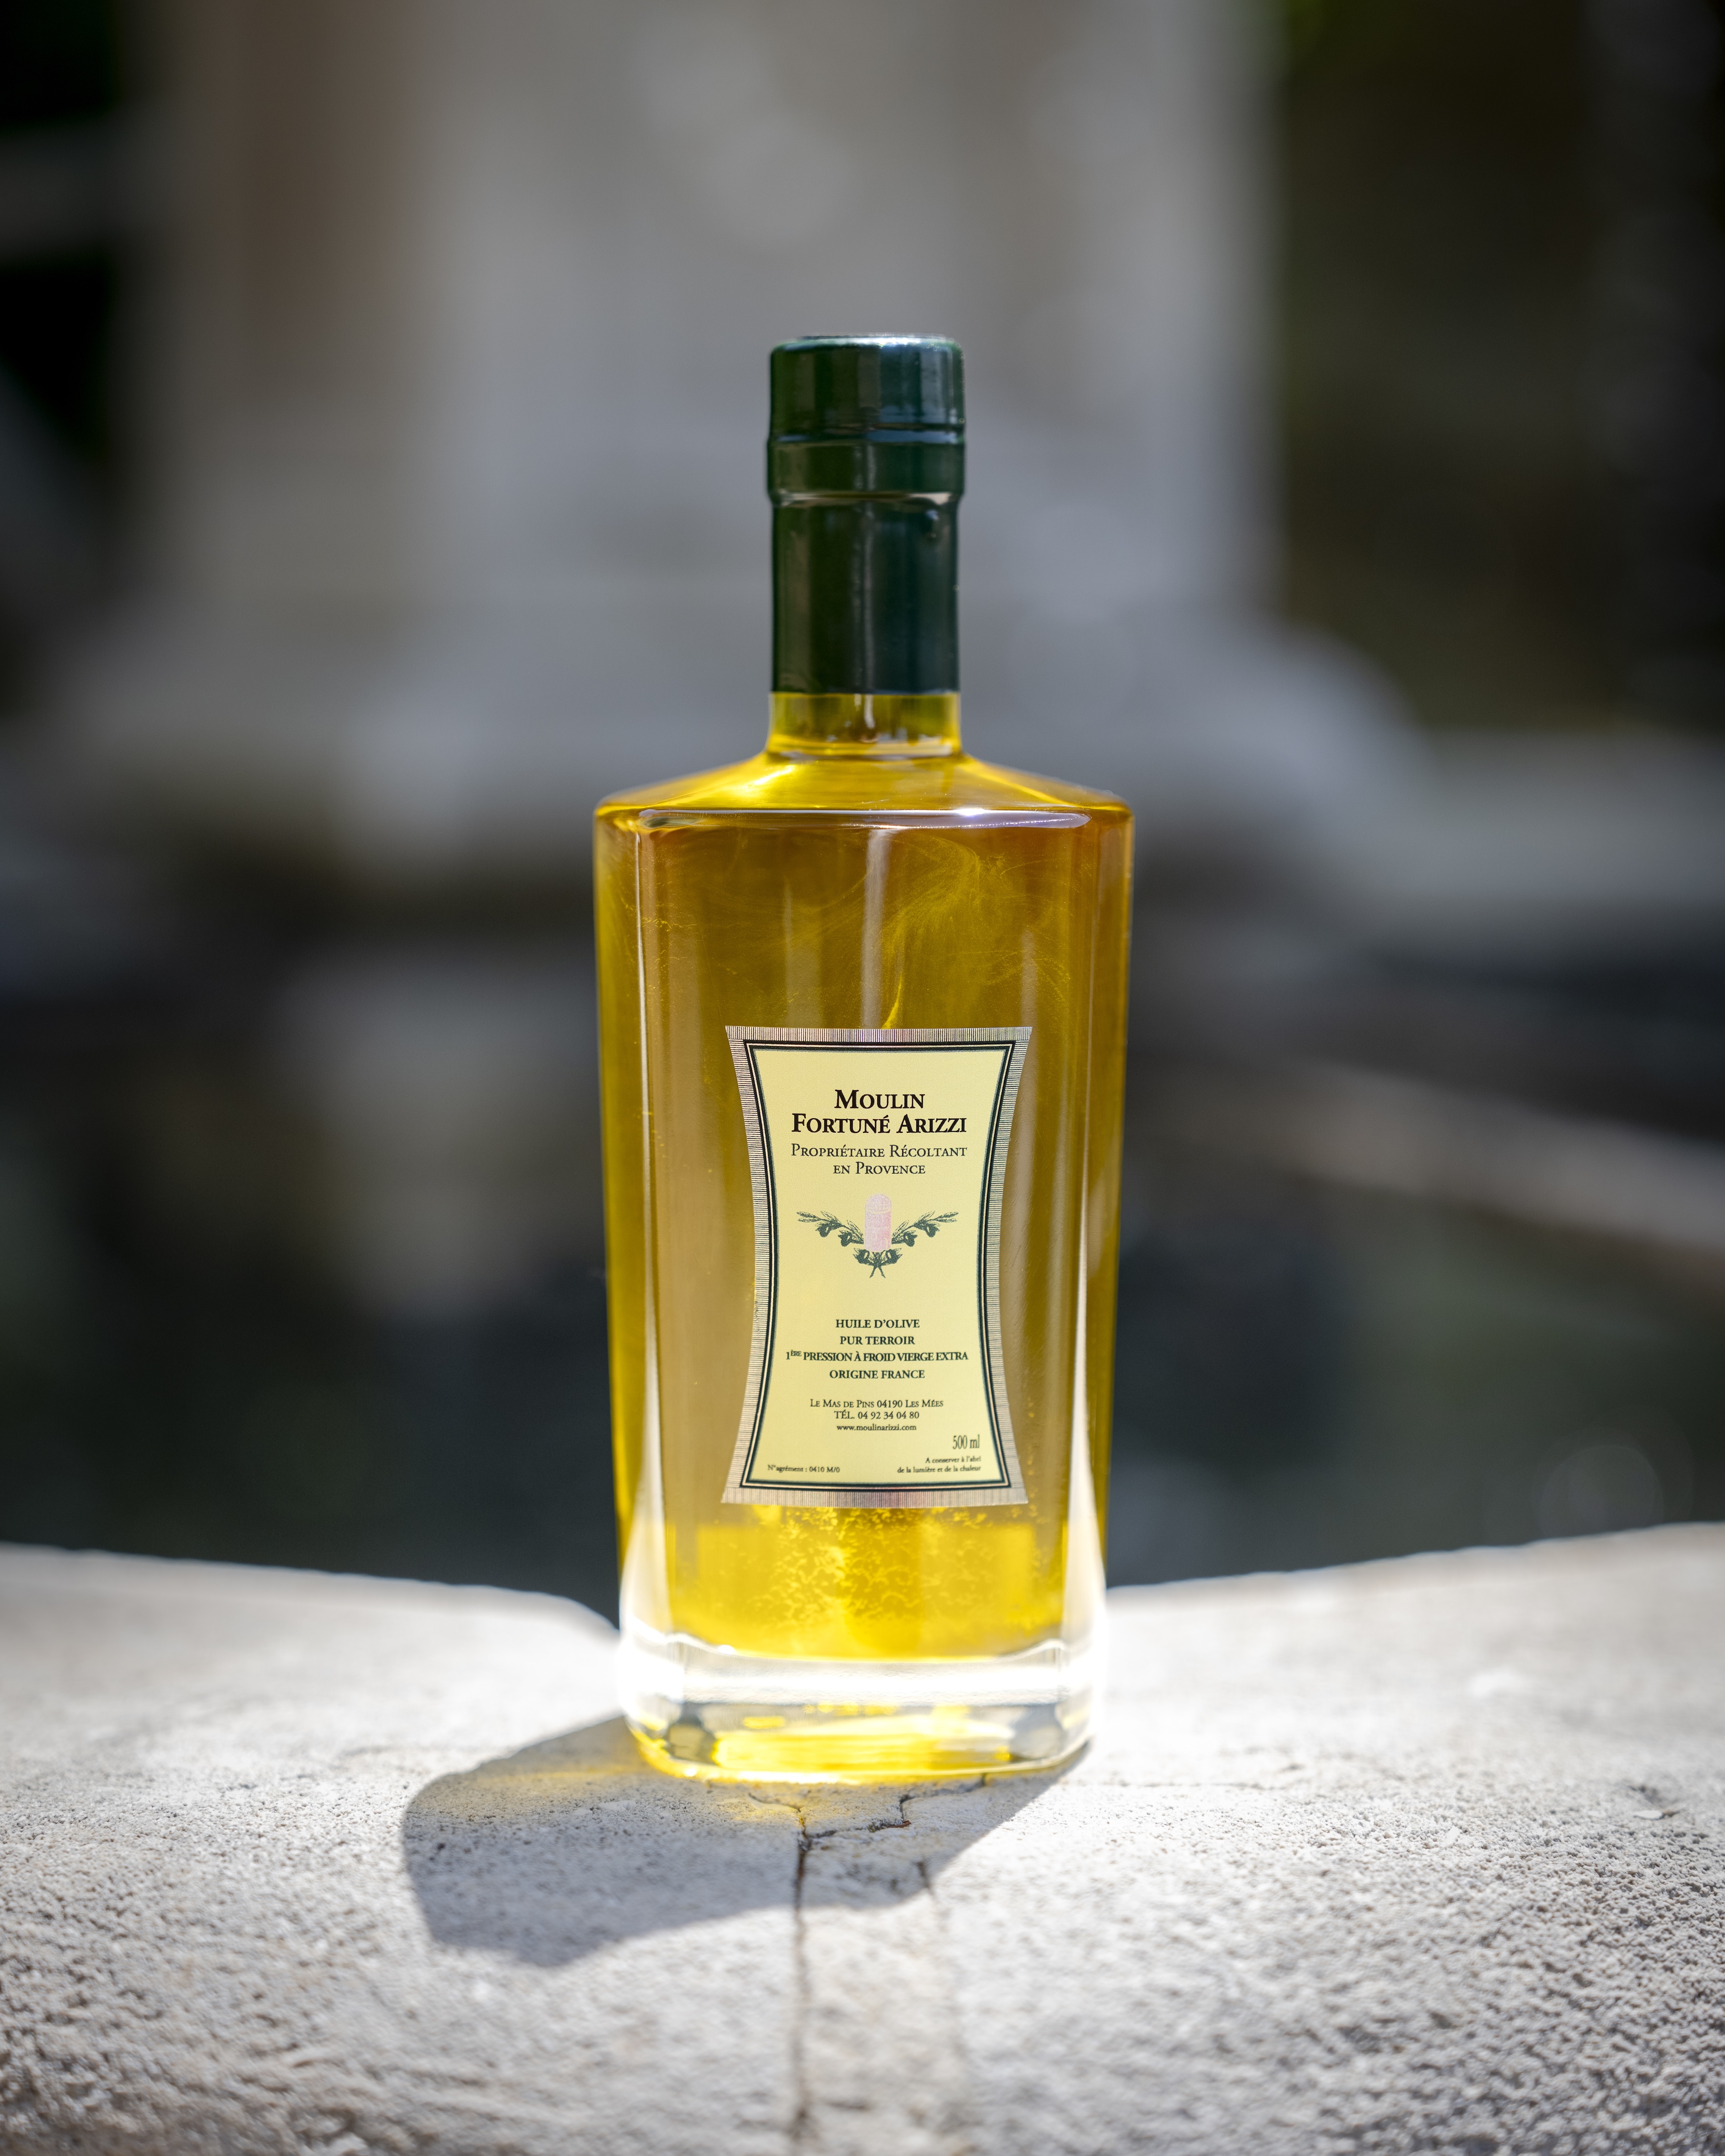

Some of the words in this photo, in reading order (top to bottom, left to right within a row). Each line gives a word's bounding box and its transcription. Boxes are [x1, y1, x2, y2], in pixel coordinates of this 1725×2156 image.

[834, 1089, 926, 1109] MOULIN
[791, 1113, 891, 1134] FORTUNÉ
[896, 1114, 967, 1133] ARIZZI
[791, 1143, 885, 1157] PROPRIÉTAIRE
[889, 1144, 968, 1157] RÉCOLTANT
[833, 1165, 851, 1174] EN
[855, 1161, 926, 1174] PROVENCE
[836, 1319, 871, 1328] HUILE
[874, 1319, 920, 1329] D'OLIVE
[839, 1336, 863, 1345] PUR
[864, 1336, 915, 1345] TERROIR
[803, 1351, 853, 1362] PRESSION
[853, 1350, 862, 1362] À
[863, 1353, 896, 1362] FROID
[896, 1352, 934, 1362] VIERGE
[935, 1351, 968, 1361] EXTRA
[829, 1370, 879, 1379] ORIGINE
[881, 1369, 925, 1379] FRANCE
[810, 1398, 820, 1407] LE
[822, 1399, 841, 1408] MAS
[856, 1399, 875, 1408] PINS
[877, 1399, 903, 1408] 04190
[905, 1399, 919, 1408] LES
[921, 1399, 944, 1408] MÉES
[834, 1409, 855, 1419] TÉL.
[858, 1411, 868, 1419] 04
[870, 1412, 881, 1420] 92
[883, 1411, 894, 1420] 34
[896, 1411, 907, 1419] 04
[836, 1423, 917, 1431] www.moulinarizzi.com
[952, 1435, 968, 1450] 500
[969, 1434, 980, 1449] ml
